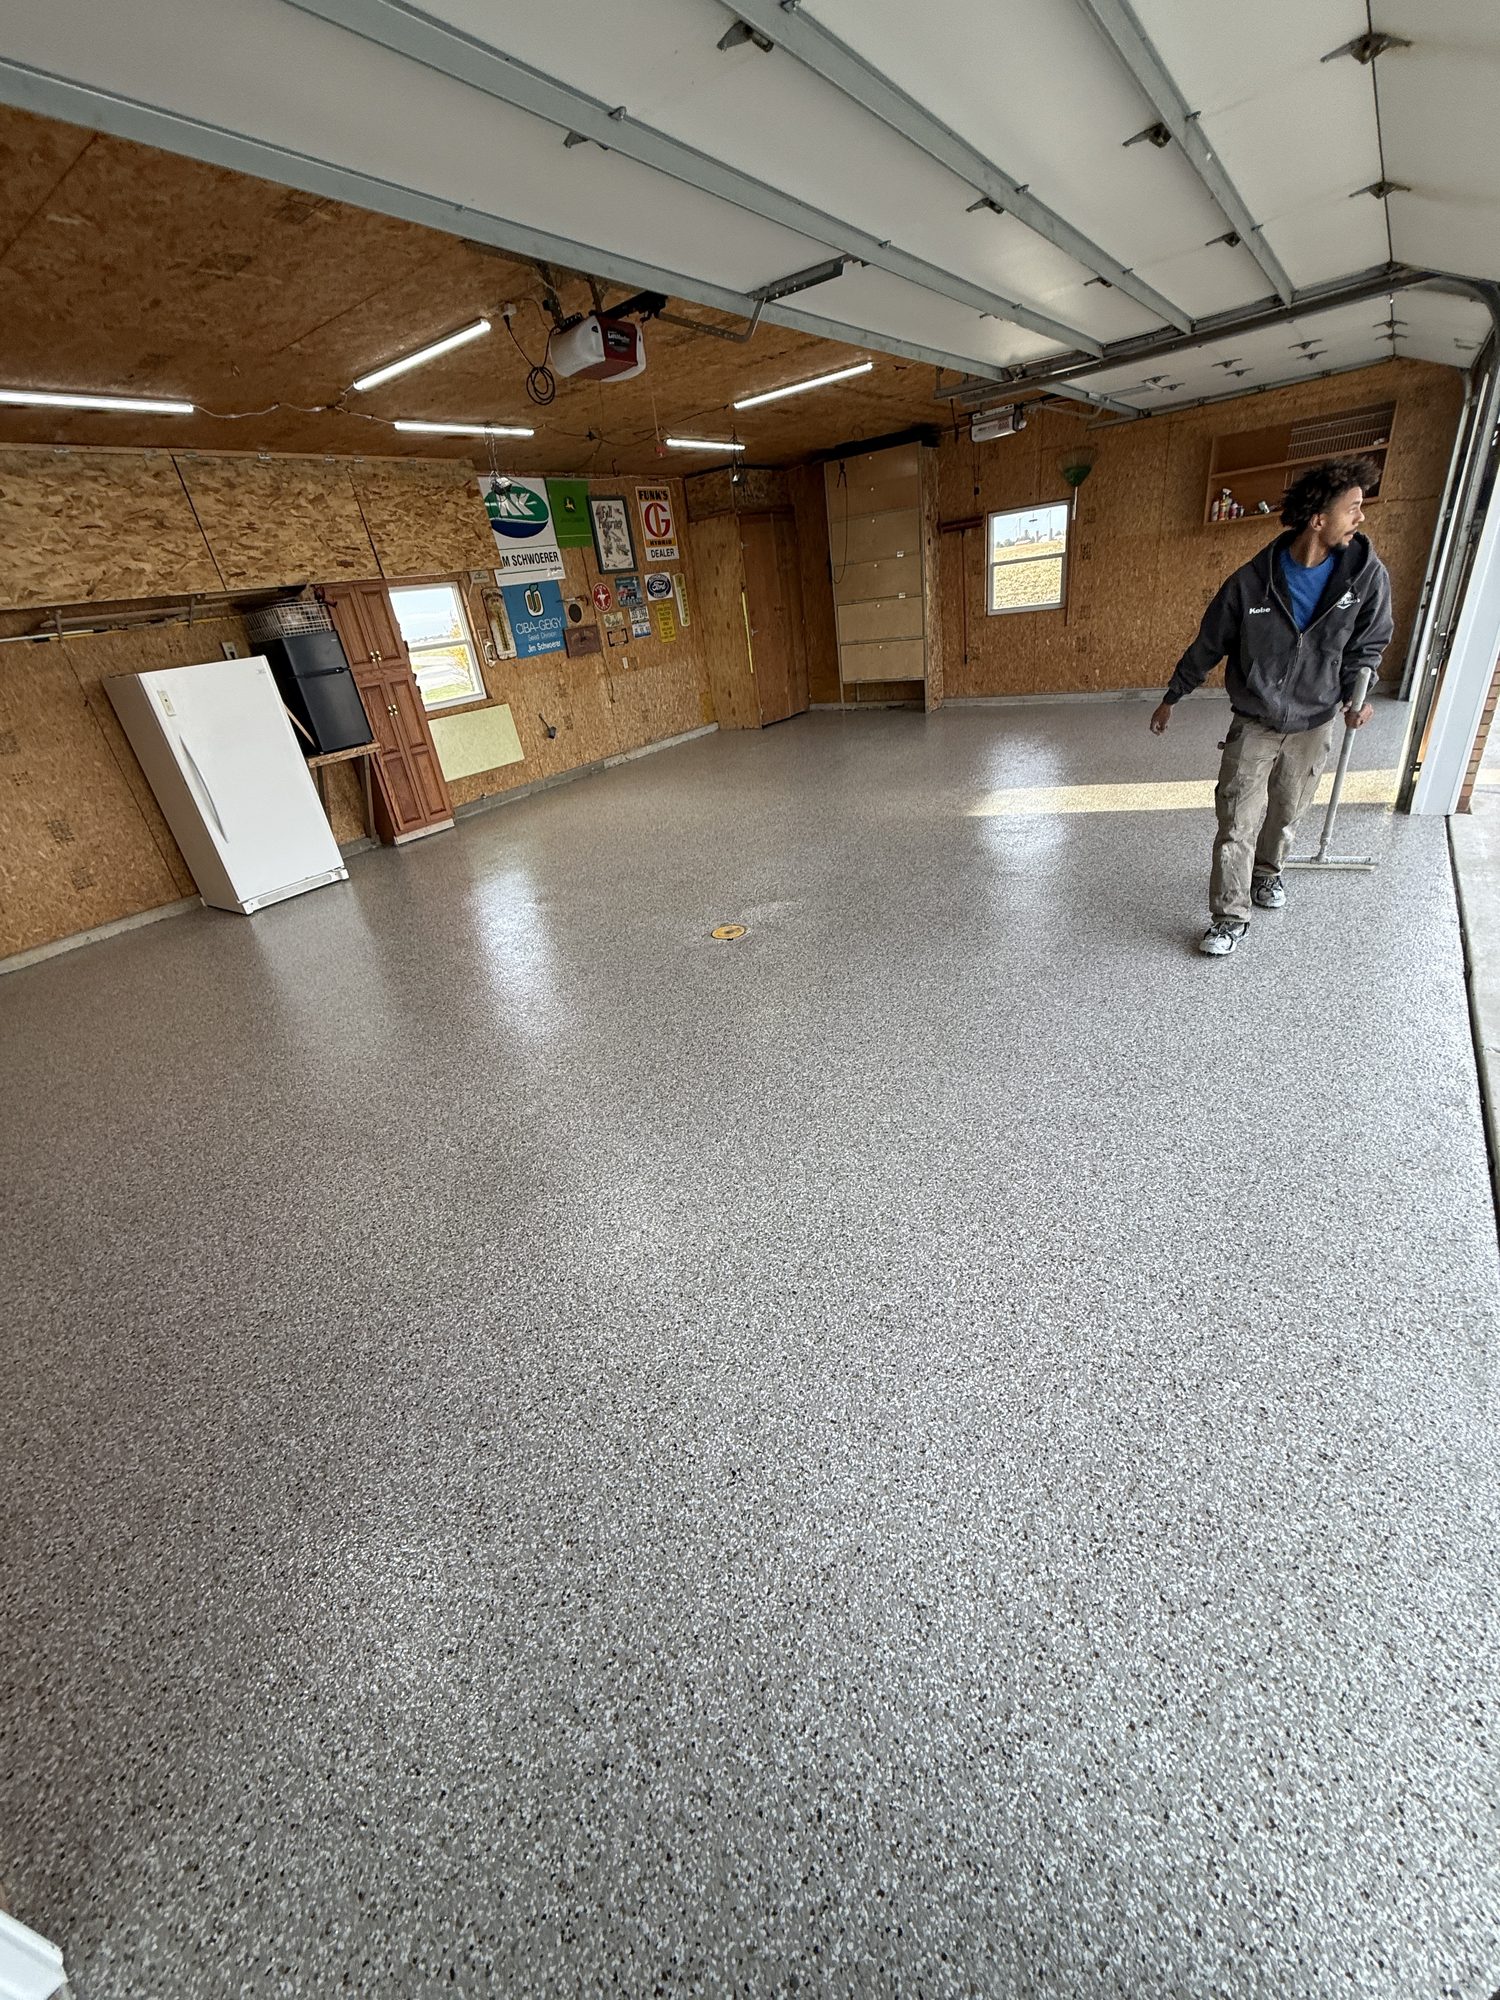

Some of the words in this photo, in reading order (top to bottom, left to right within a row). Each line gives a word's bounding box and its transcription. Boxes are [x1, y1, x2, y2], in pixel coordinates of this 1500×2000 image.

[639, 490, 668, 500] FUNK'S
[651, 548, 675, 558] DEALER
[511, 551, 559, 566] SCHWOERER
[1249, 606, 1271, 614] Kobe
[515, 617, 562, 634] CIBA-GEIGY
